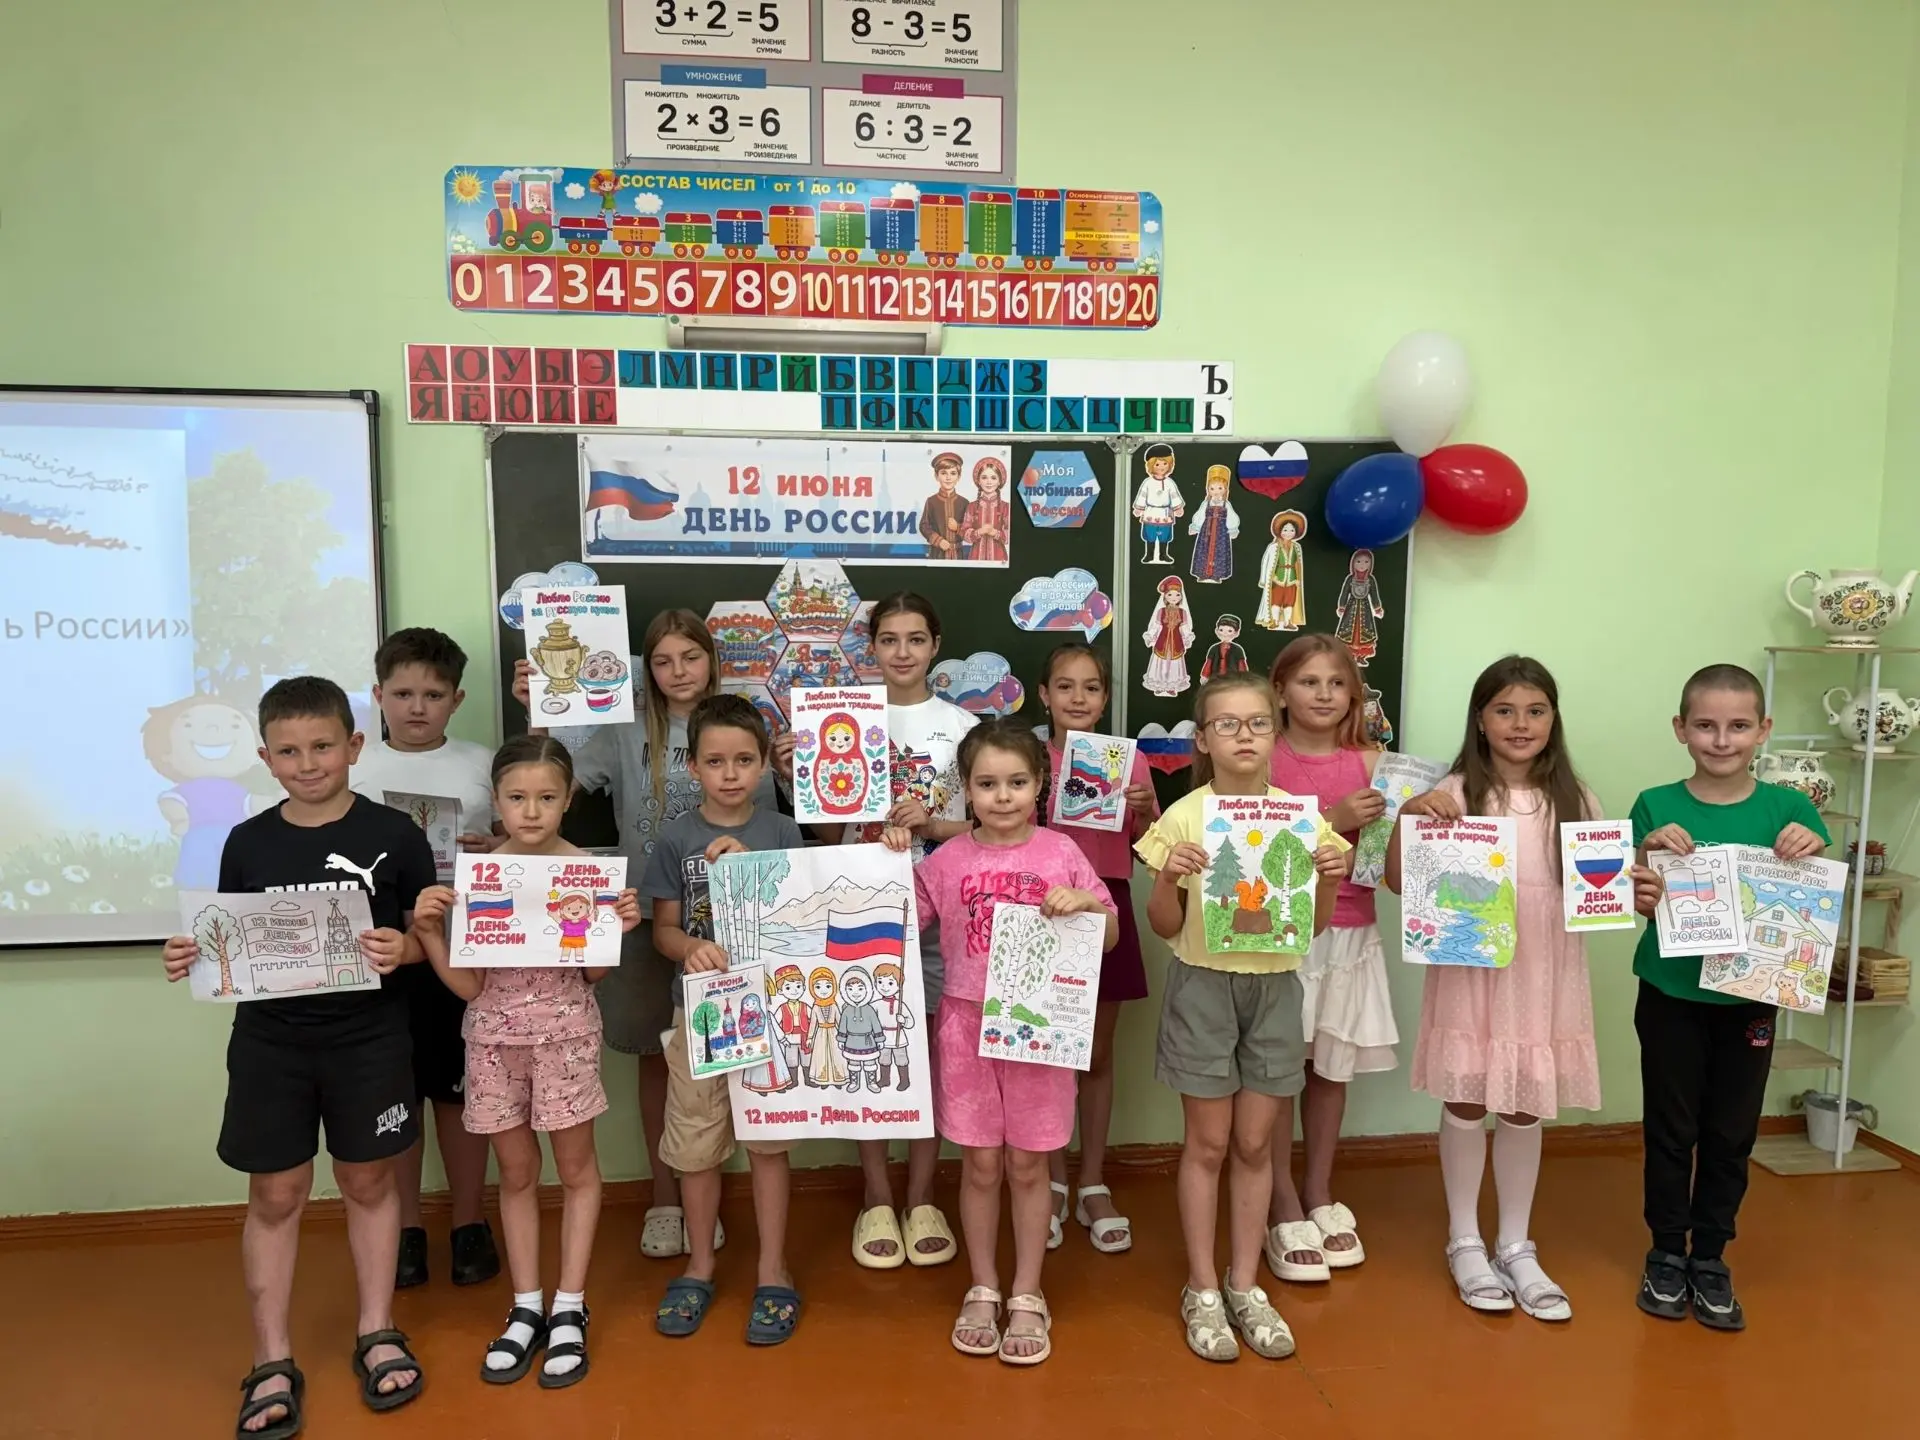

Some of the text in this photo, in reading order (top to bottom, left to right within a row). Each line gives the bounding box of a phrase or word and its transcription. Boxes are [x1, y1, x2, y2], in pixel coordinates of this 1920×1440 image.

[681, 38, 707, 46] СУММА
[751, 37, 787, 46] ЗНАЧЕНИЕ
[871, 48, 906, 57] РАЗНОСТЬ
[944, 48, 979, 57] ЗНАЧЕНИЕ
[944, 57, 979, 65] РАЗНОСТИ
[685, 71, 743, 83] УМНОЖЕНИЕ
[893, 81, 934, 92] ДЕЛЕНИЕ
[644, 90, 740, 102] МНОЖИТЕЛЬ МНОЖИТЕЛЬ
[848, 99, 931, 111] ДЕЛИМОЕ ДЕЛИТЕЛЬ
[666, 143, 720, 153] ПРОИЗВЕДЕНИЕ
[752, 142, 789, 151] ЗНАЧЕНИЕ
[744, 150, 798, 160] ПРОИЗВЕДЕНИЯ
[876, 153, 907, 162] ЧАСТНОЕ
[945, 151, 979, 160] ЗНАЧЕНИЕ
[945, 159, 979, 168] ЧАСТНОГО
[619, 173, 856, 195] СОСТАВ ЧИСЕЛ от 1 до 10
[987, 193, 994, 201] 9
[1033, 190, 1045, 198] 10
[889, 200, 896, 208] 7
[938, 196, 945, 204] 8
[788, 207, 795, 215] 5
[839, 202, 846, 211] 6
[685, 214, 692, 222] 3
[736, 211, 743, 219] 4
[580, 219, 586, 227] 1
[633, 217, 640, 225] 2
[455, 263, 1157, 321] 0 1 2 3 4 5 6 7 8 9 10 11 12 13 14 15 16 17 18 19 20
[1043, 464, 1075, 476] Моя
[728, 466, 873, 498] 12 июня
[1024, 482, 1093, 497] любимая
[683, 507, 918, 535] ДЕНЬ РОССИИ
[34, 611, 190, 639] России»
[805, 690, 871, 701] Люблю Россию
[807, 702, 846, 713] народные
[848, 702, 884, 713] традиции
[1218, 799, 1304, 812] Люблю Россию
[1233, 810, 1291, 821] за её леса
[1415, 819, 1497, 832] Люблю Россию
[1421, 831, 1500, 846] за её природу
[1576, 830, 1621, 842] 12 ИЮНЯ
[1737, 850, 1780, 865] Люблю
[471, 862, 501, 883] 12
[563, 864, 601, 876] ДЕНЬ
[552, 876, 610, 888] РОССИИ
[1738, 864, 1828, 889] за родной дом
[470, 883, 503, 892] ИЮНЯ
[1584, 891, 1616, 904] ДЕНЬ
[1577, 903, 1623, 915] РОССИИ
[251, 917, 309, 927] 12 ИЮНЯ
[474, 921, 510, 933] ДЕНЬ
[1681, 916, 1721, 930] ДЕНЬ
[263, 929, 301, 941] ДЕНЬ
[465, 933, 526, 945] РОССИИ
[1670, 928, 1733, 943] РОССИИ
[256, 943, 313, 954] РОССИИ
[717, 976, 744, 988] ИЮНЯ
[744, 1106, 920, 1125] 12 июня День России
